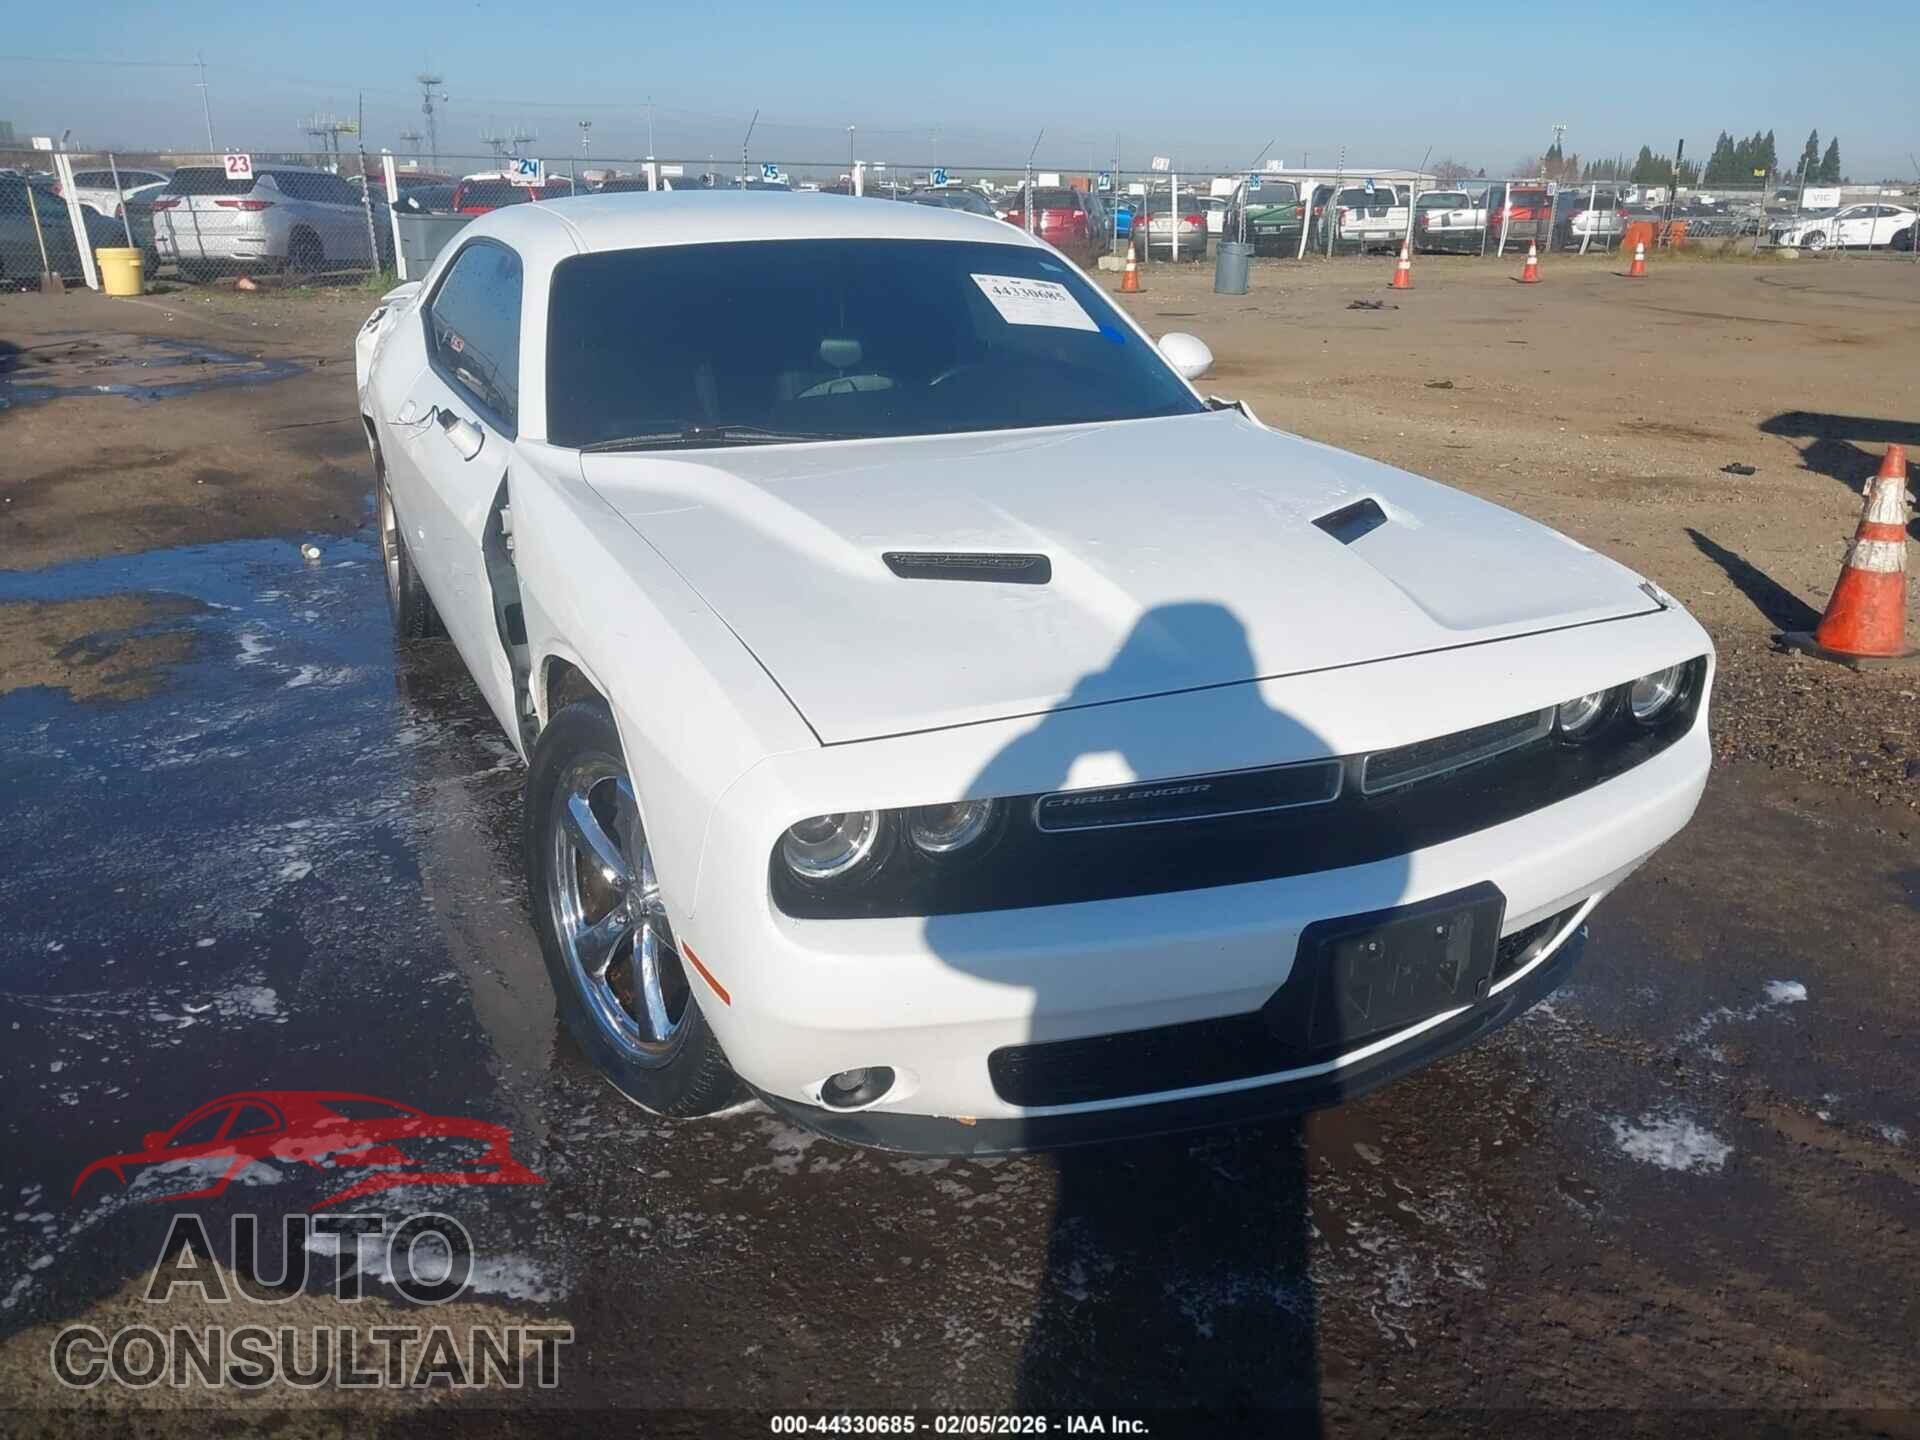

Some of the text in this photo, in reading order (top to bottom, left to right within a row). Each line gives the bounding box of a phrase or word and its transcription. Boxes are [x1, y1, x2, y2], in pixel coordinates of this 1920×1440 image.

[227, 156, 249, 172] 23
[520, 159, 537, 177] 24
[762, 163, 778, 180] 25
[934, 168, 948, 184] 26
[992, 286, 1066, 301] 44330685
[1046, 784, 1212, 808] CHALLENGER
